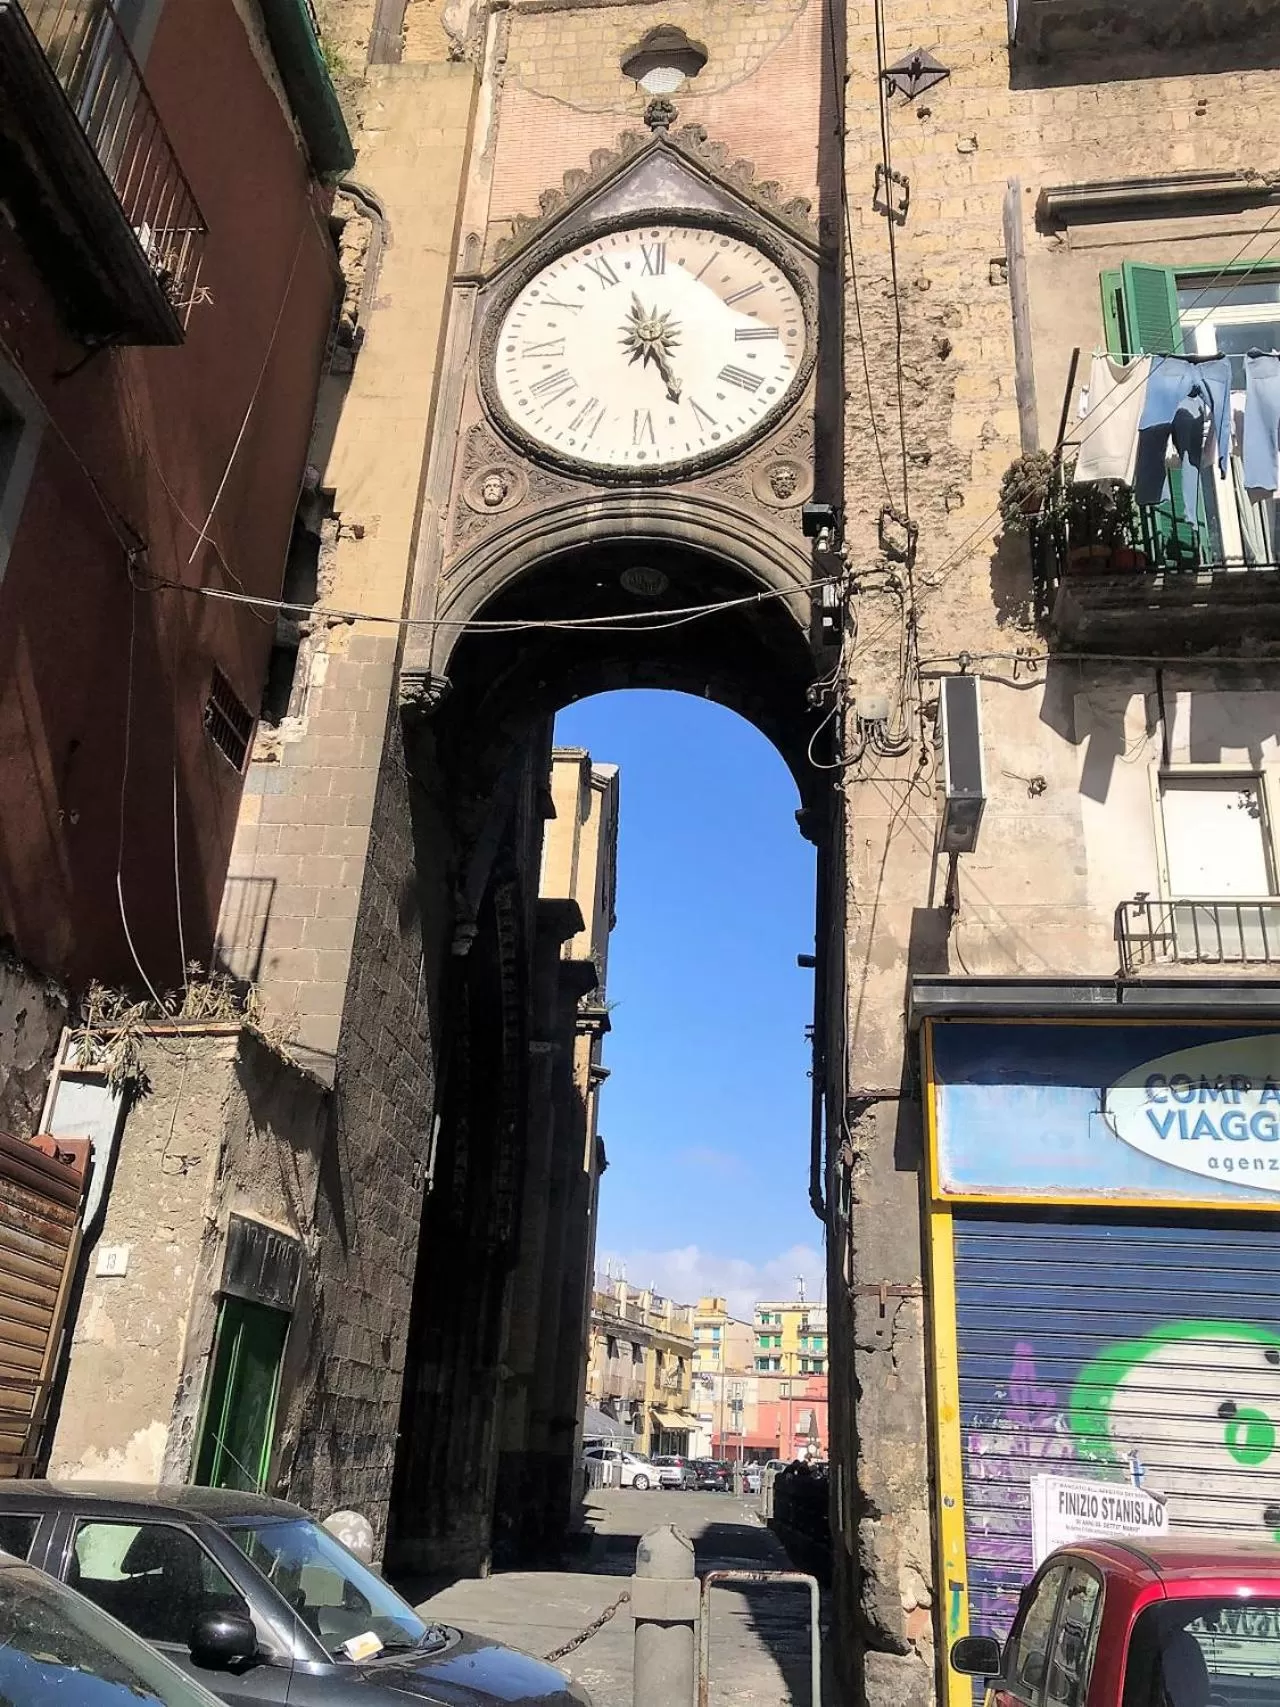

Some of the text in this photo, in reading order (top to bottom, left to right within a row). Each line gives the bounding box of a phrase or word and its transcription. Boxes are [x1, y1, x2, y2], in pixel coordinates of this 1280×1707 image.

[584, 255, 621, 290] XI
[640, 243, 666, 276] XII
[694, 251, 720, 281] I
[540, 293, 584, 316] X
[722, 281, 765, 306] II
[735, 327, 779, 342] III
[717, 364, 766, 393] IIII
[687, 396, 718, 432] V
[1146, 1108, 1280, 1142] VIAGG
[1207, 1156, 1280, 1172] agenz
[1058, 1491, 1099, 1519] FINIZIO
[1101, 1496, 1163, 1527] STANISLAO
